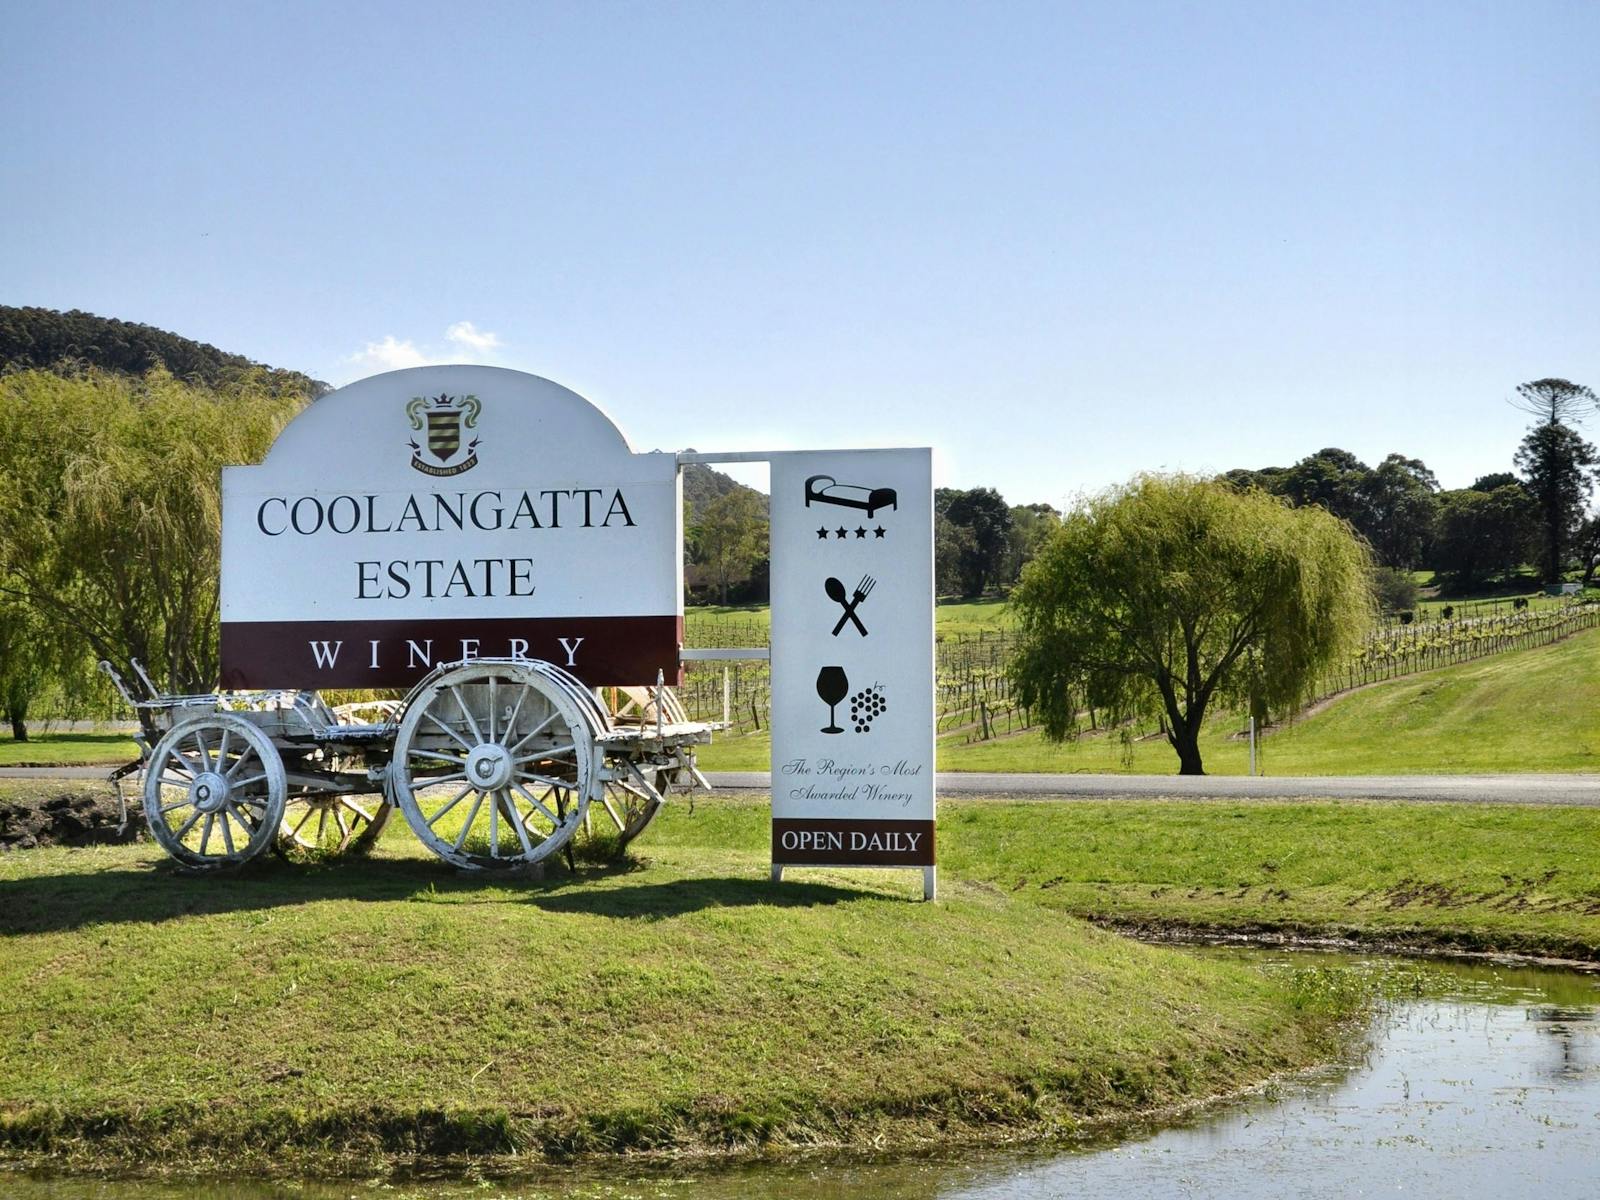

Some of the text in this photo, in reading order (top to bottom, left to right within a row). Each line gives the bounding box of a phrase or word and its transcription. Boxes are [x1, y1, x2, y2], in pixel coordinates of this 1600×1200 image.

[414, 461, 457, 475] ESTABLISHED
[257, 488, 637, 536] COOLANGATTA
[354, 558, 535, 599] ESTATE
[782, 758, 922, 781] The Region's Most
[789, 784, 913, 807] Awarded Winery
[781, 831, 922, 851] OPEN DAILY
